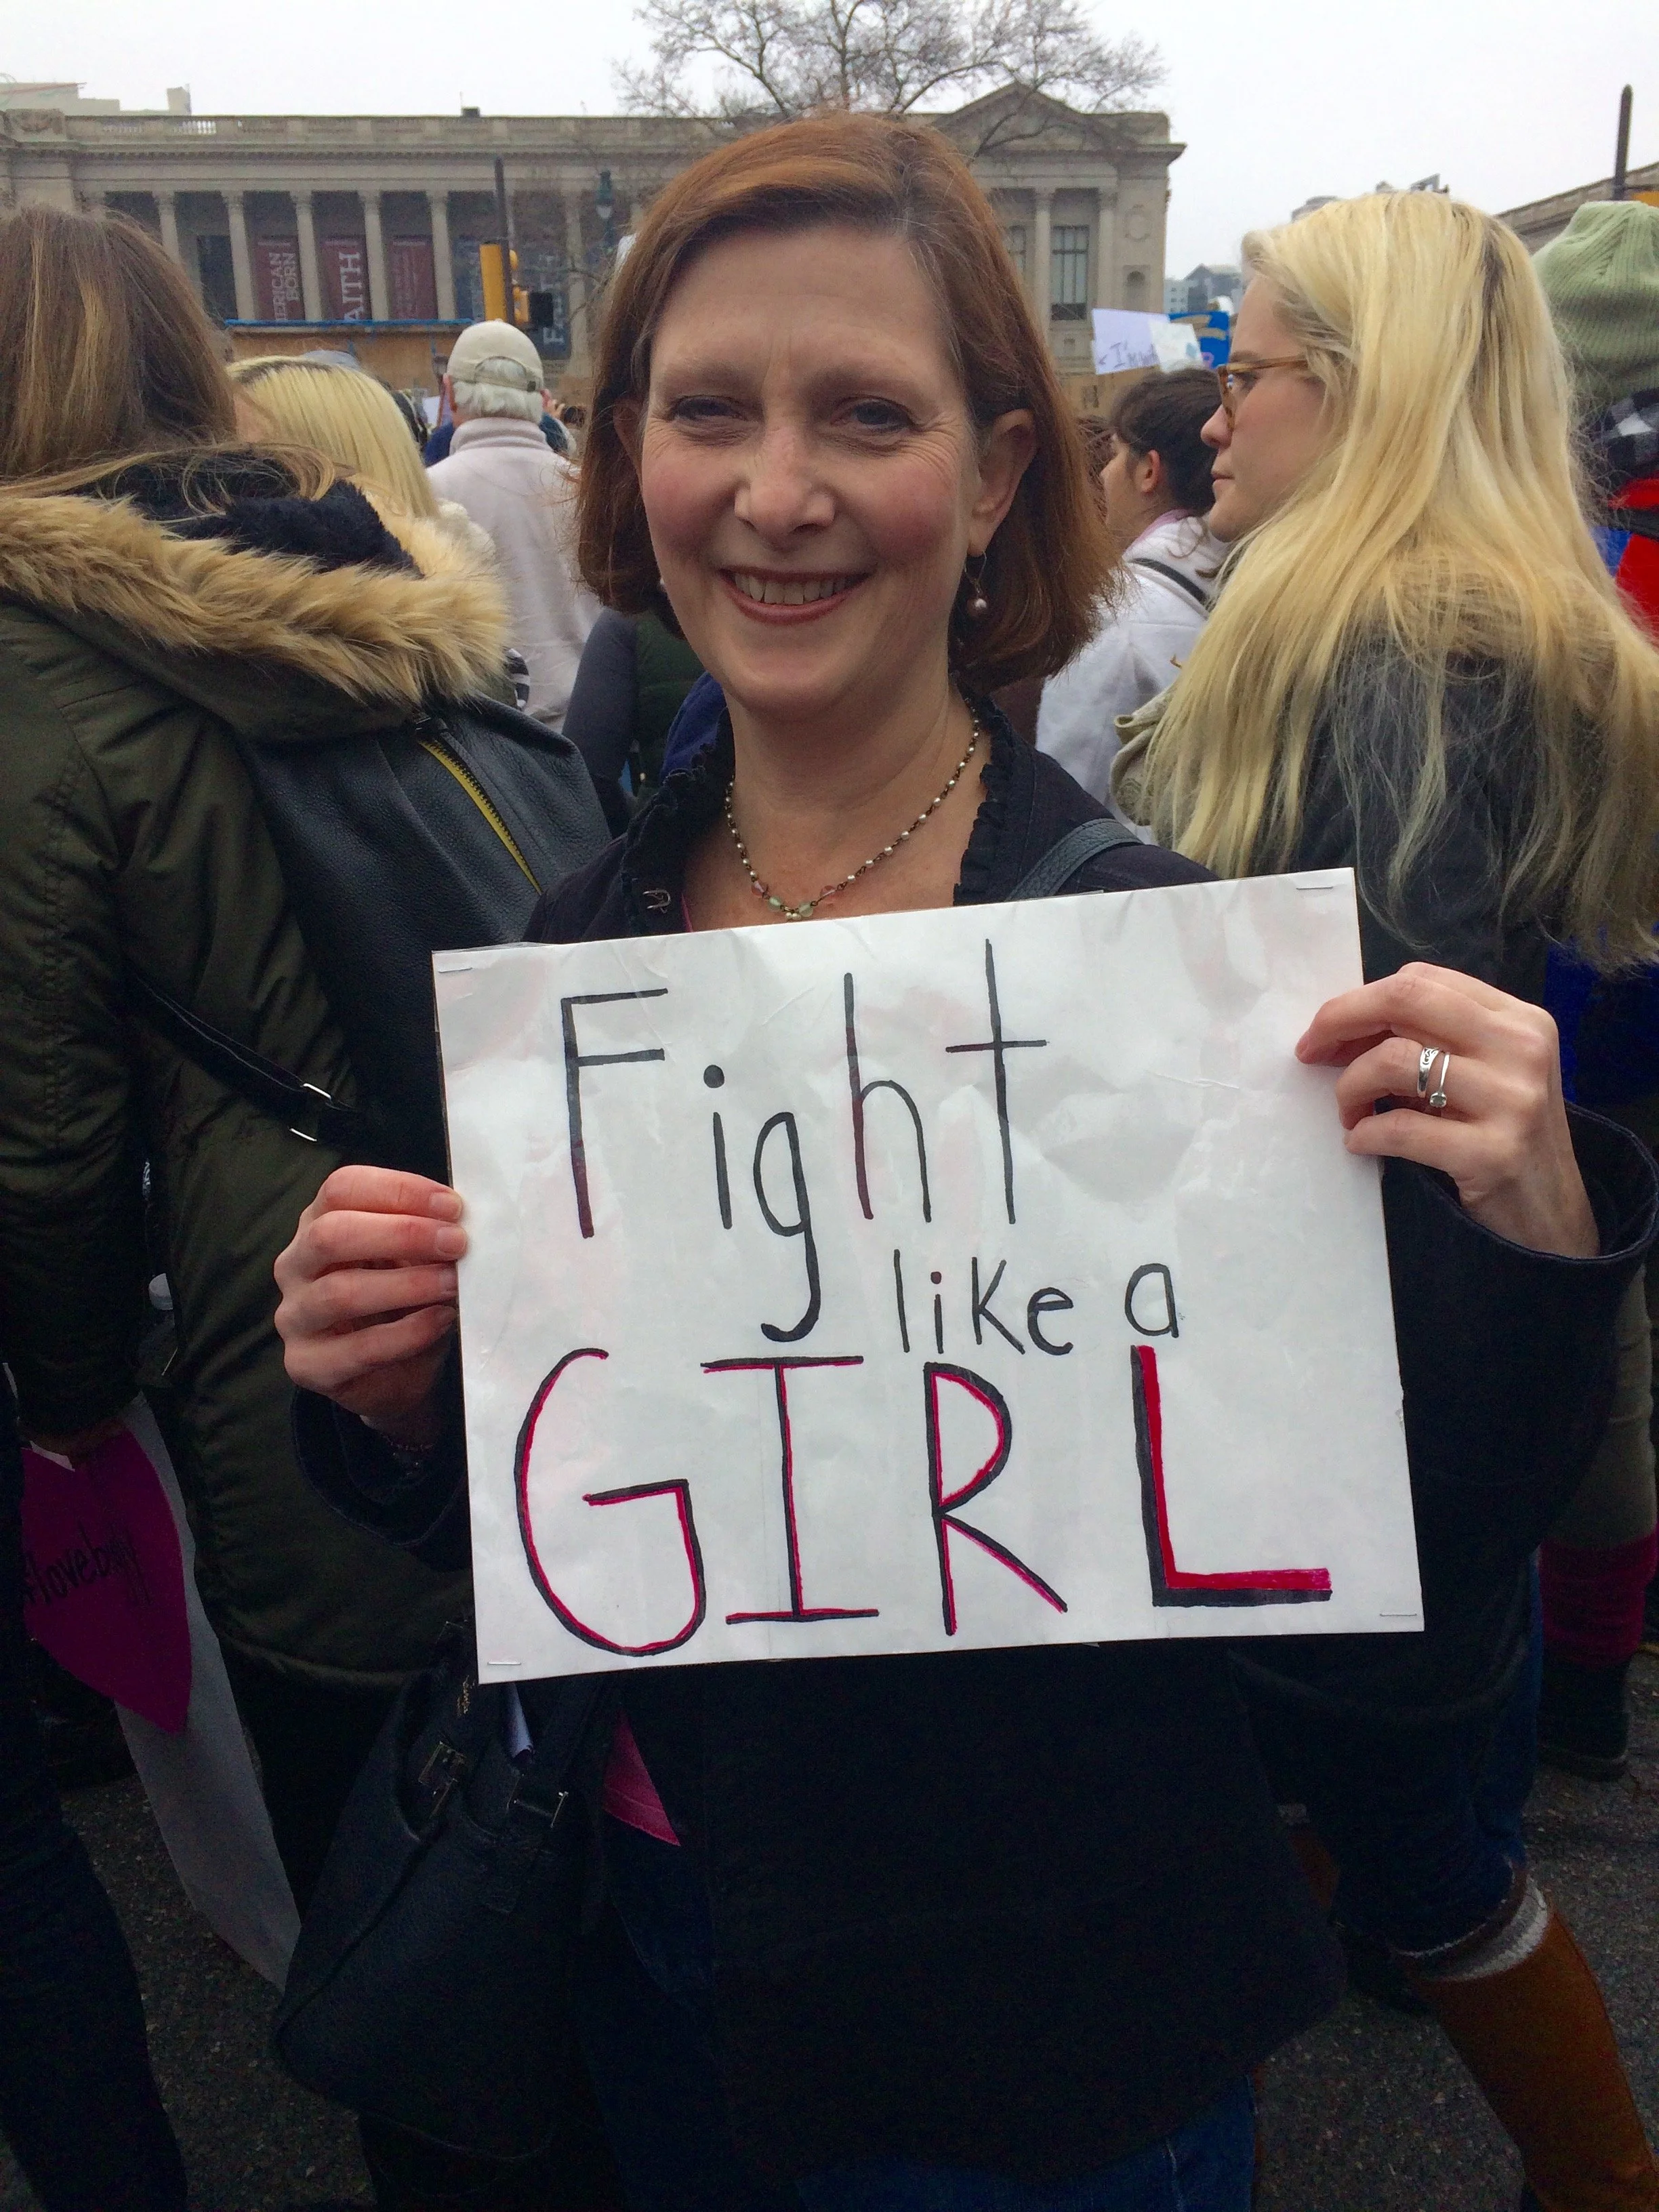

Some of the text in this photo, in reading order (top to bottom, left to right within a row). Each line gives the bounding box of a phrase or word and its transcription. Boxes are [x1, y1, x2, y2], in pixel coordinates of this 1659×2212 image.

[282, 251, 300, 302] BORN
[560, 939, 1048, 1341] Fight
[893, 1249, 1181, 1356] like a
[513, 1345, 1332, 1658] GIRL
